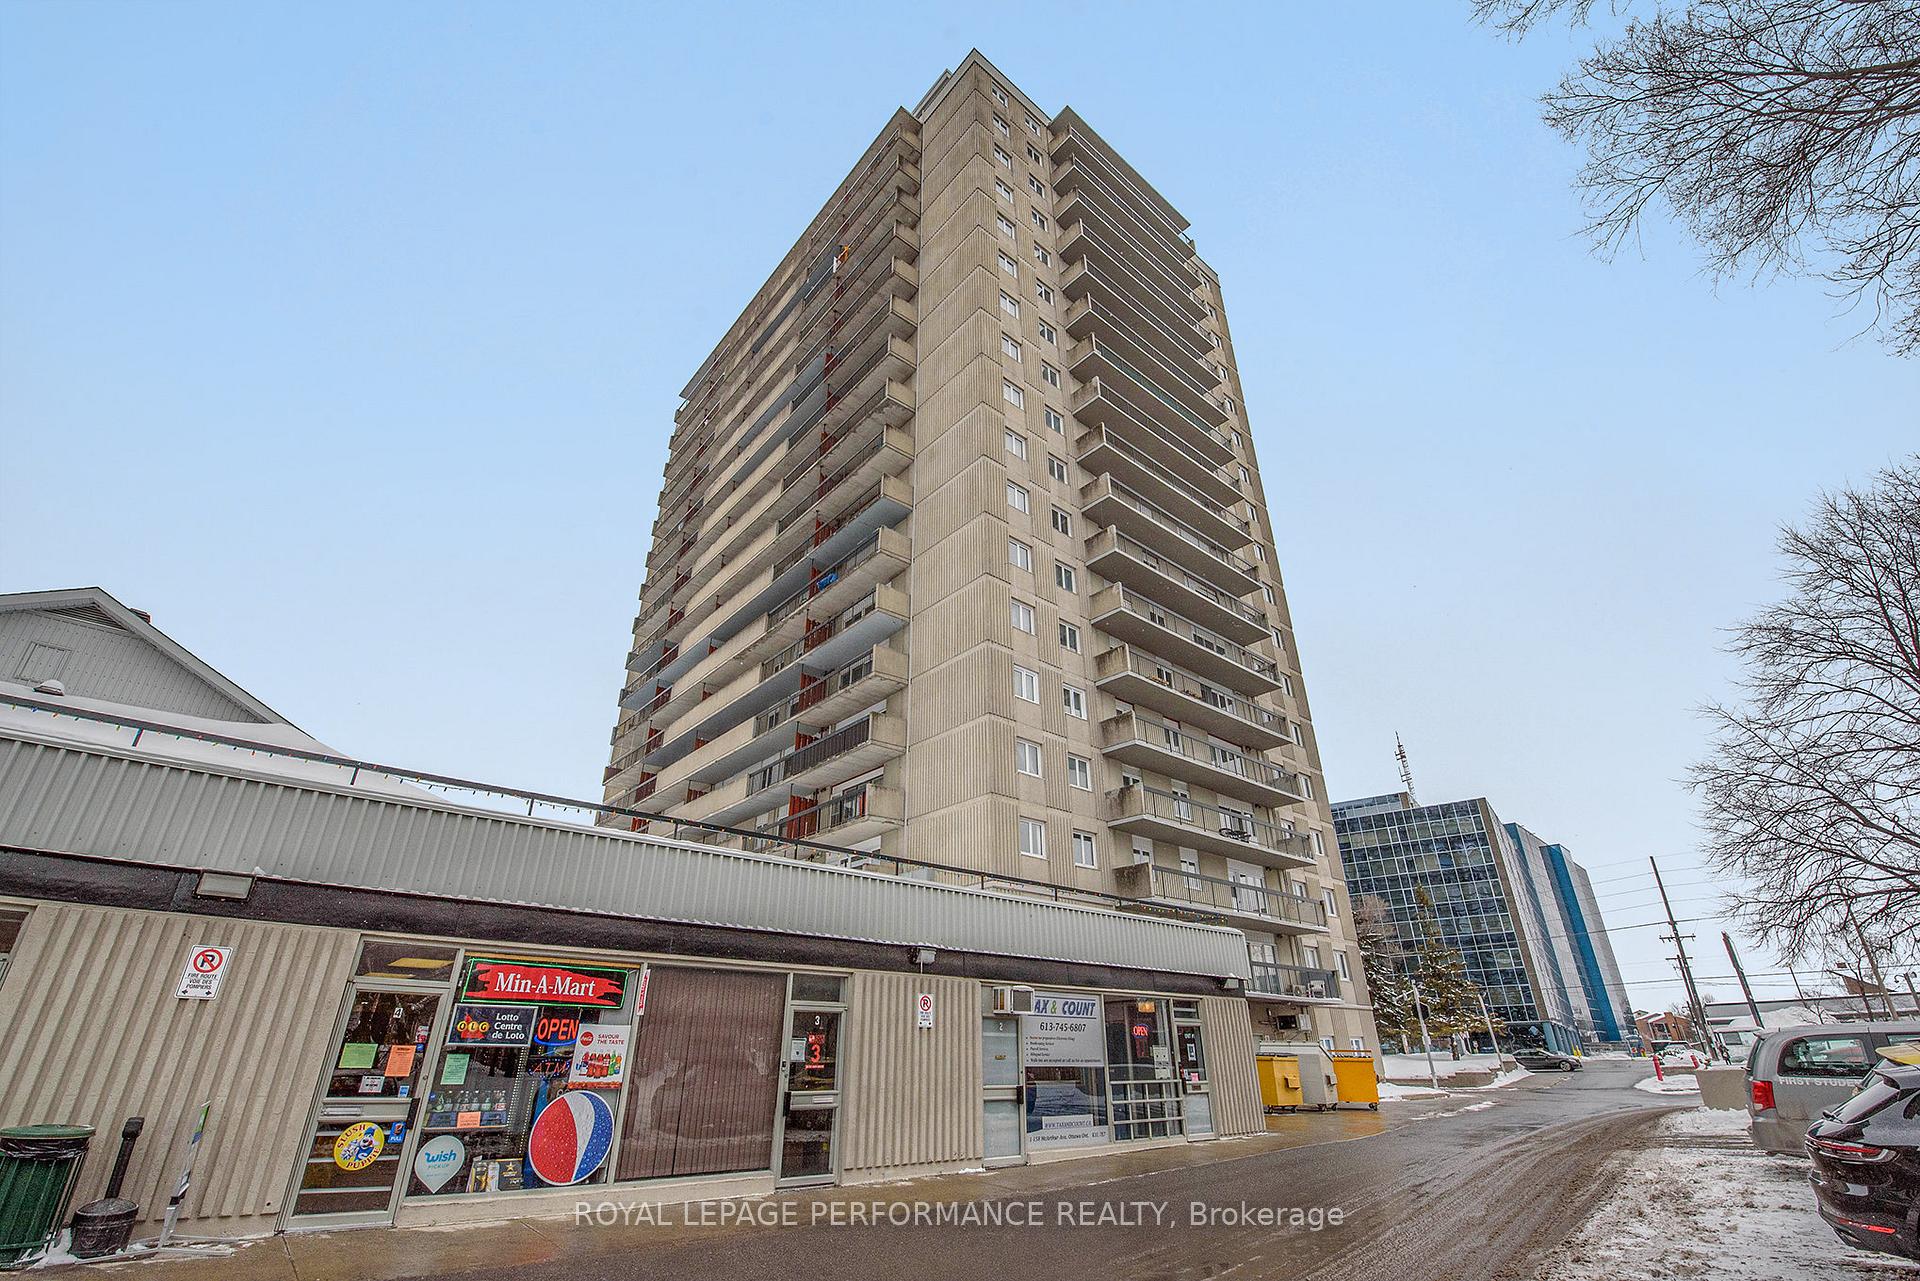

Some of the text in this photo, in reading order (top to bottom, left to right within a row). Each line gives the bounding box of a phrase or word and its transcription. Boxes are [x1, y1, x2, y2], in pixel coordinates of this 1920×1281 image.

[494, 972, 596, 997] Min-A-Mart
[395, 1008, 402, 1016] 4
[1034, 999, 1096, 1016] AX & COUNT
[496, 1012, 519, 1021] Lotto
[814, 1015, 821, 1026] 3
[458, 1021, 489, 1032] OLG
[494, 1021, 523, 1031] Centre
[537, 1018, 579, 1040] OPEN
[999, 1022, 1004, 1031] 2
[1133, 1025, 1149, 1037] OPEN
[491, 1030, 525, 1040] de Loto
[810, 1044, 821, 1063] 3
[533, 1061, 568, 1074] ATM
[1779, 1078, 1810, 1086] FIRST
[337, 1124, 366, 1148] SLUSH
[346, 1147, 381, 1169] PUPPIE
[424, 1149, 457, 1163] wish
